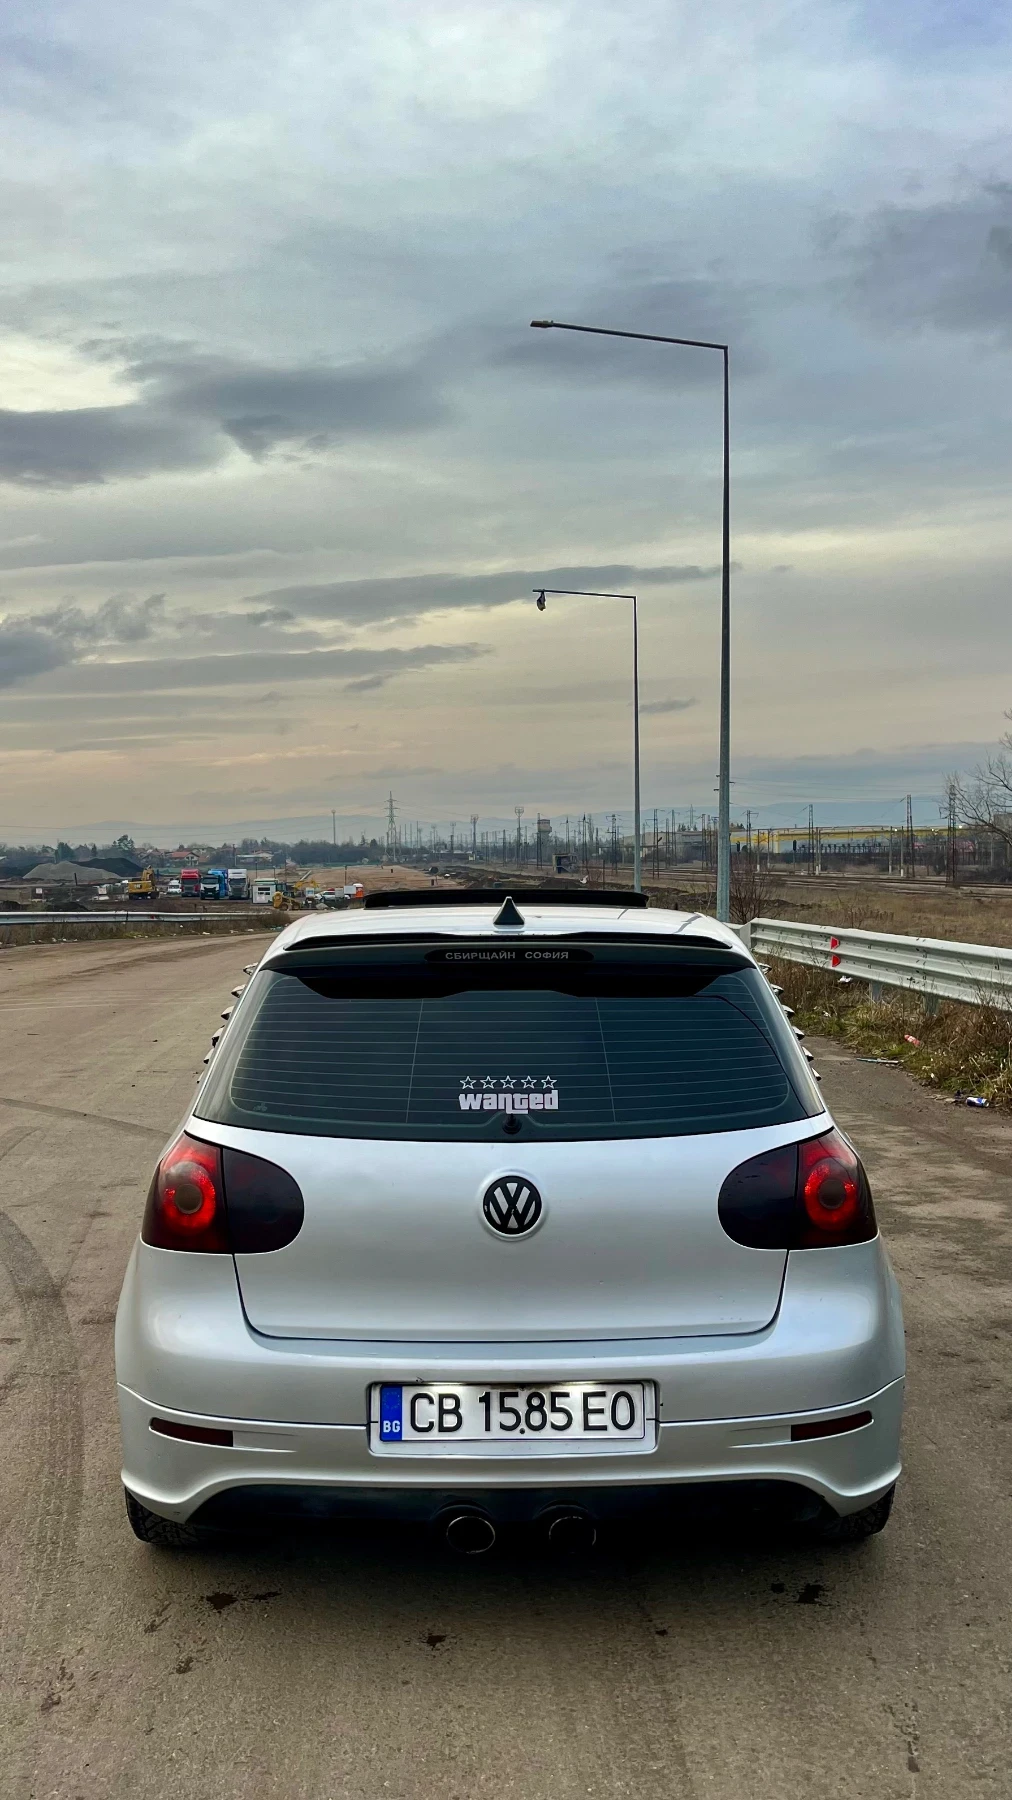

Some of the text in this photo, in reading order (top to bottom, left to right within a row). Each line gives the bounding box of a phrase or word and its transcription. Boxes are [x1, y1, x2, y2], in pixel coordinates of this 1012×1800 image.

[445, 950, 569, 960] СБИРЩАЙН СОФИЯ
[459, 1089, 559, 1115] wanted
[410, 1392, 463, 1433] CB
[478, 1391, 573, 1432] 1585
[383, 1420, 400, 1433] BG
